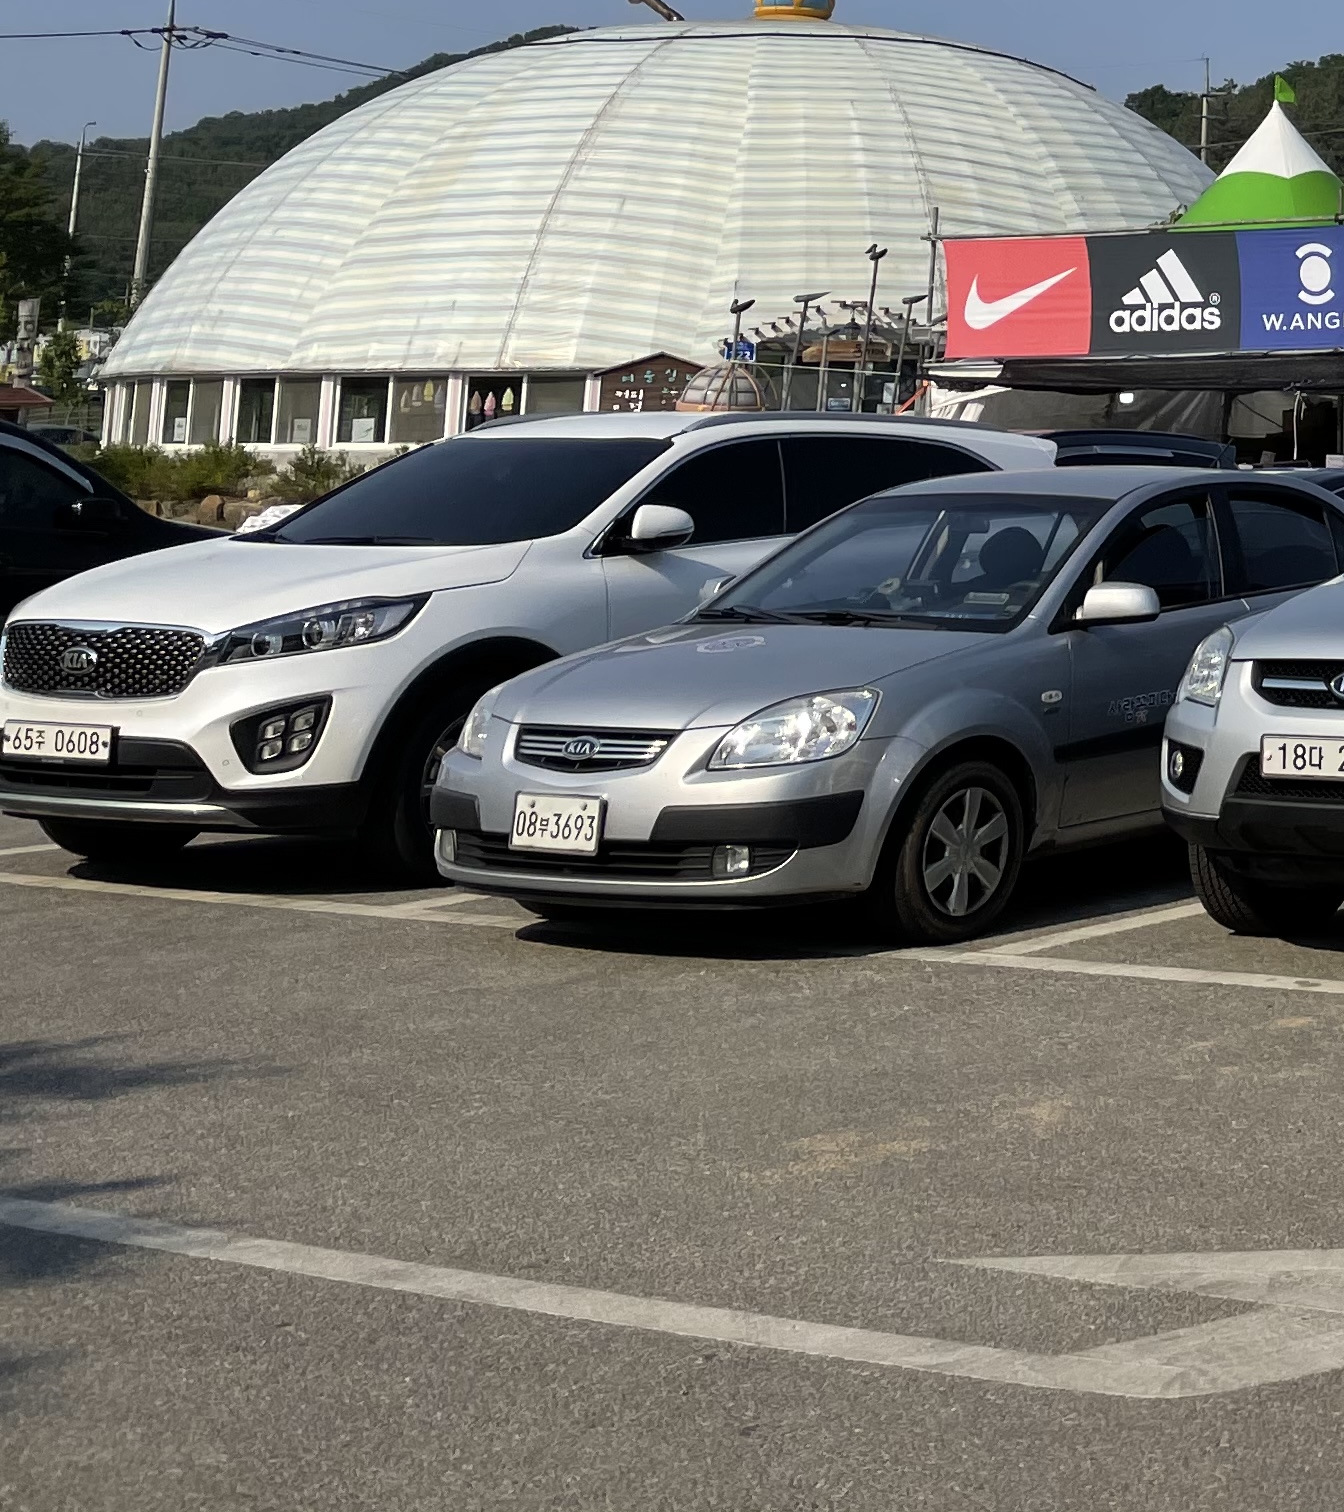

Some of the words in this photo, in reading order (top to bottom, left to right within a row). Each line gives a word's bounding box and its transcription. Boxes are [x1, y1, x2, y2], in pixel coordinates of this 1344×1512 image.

[1109, 301, 1221, 333] adidas
[63, 652, 88, 668] KIA
[12, 727, 45, 750] 65주
[54, 729, 99, 755] 0608
[566, 741, 591, 754] KIA
[1278, 742, 1324, 770] 18다
[515, 809, 596, 842] 08부3693
